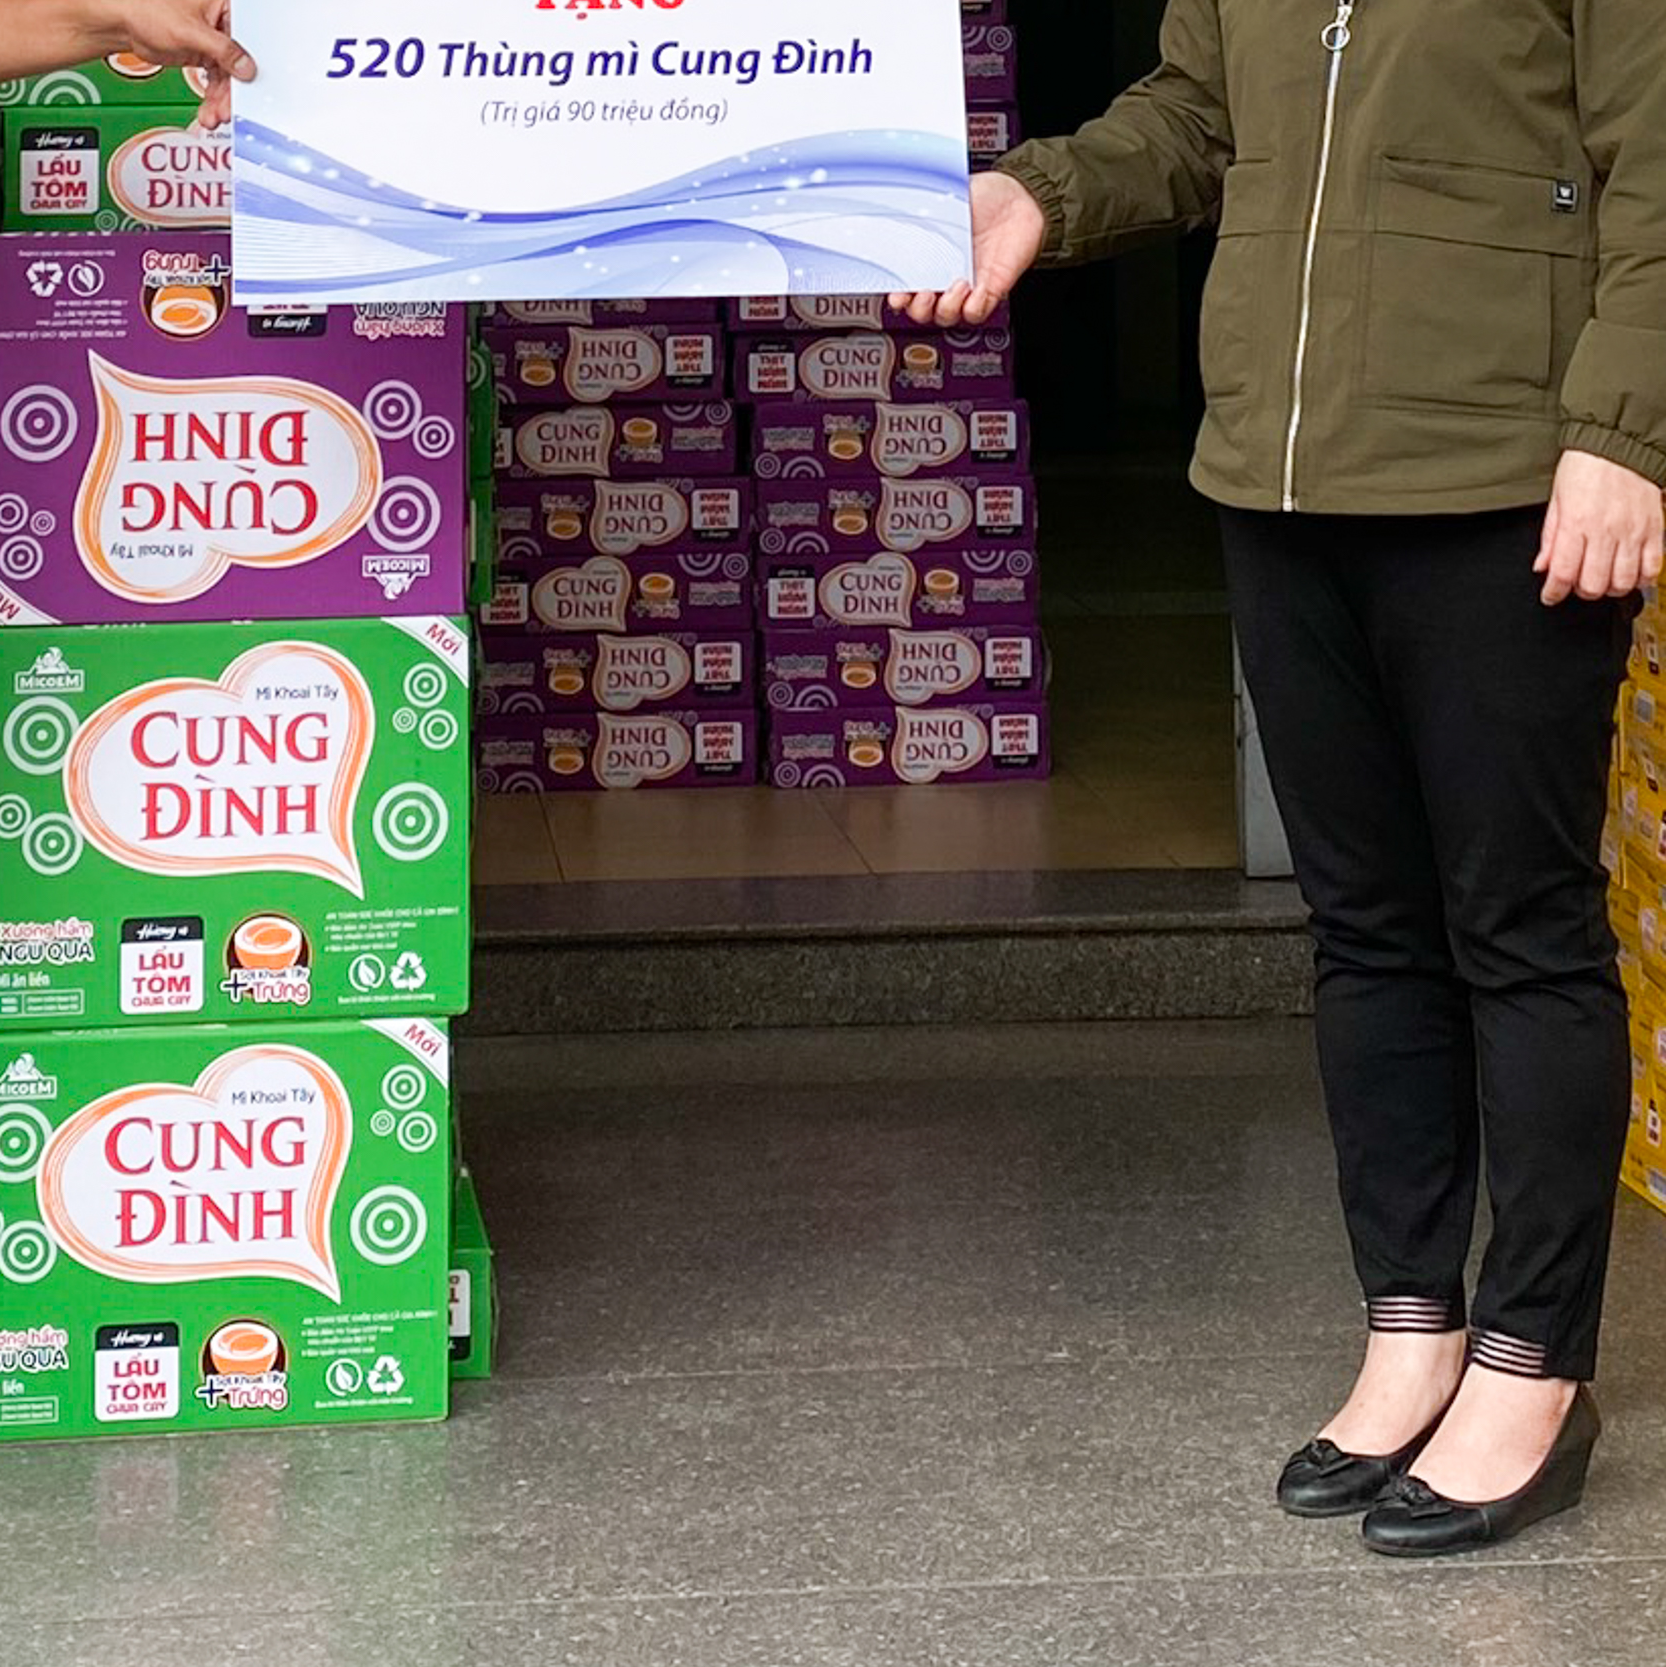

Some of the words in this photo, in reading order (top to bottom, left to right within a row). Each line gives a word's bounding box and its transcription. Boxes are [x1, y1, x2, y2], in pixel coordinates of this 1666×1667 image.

[326, 37, 425, 78] 520
[438, 41, 575, 87] Thùng
[586, 40, 639, 76] mì
[651, 41, 761, 85] Cung
[772, 38, 873, 75] Đình
[480, 100, 518, 127] (Trị
[523, 100, 560, 128] giá
[568, 101, 595, 122] 90
[601, 100, 653, 126] triệu
[660, 98, 729, 126] đồng)
[132, 410, 311, 474] ĐÌNH
[120, 480, 319, 533] CUNG
[426, 623, 463, 656] Mới
[131, 711, 331, 769] CUNG
[140, 774, 323, 841] ĐÌNH
[133, 974, 191, 994] TÔM
[404, 1024, 441, 1057] Mới
[103, 1116, 307, 1175] CUNG
[115, 1180, 299, 1247] ĐÌNH
